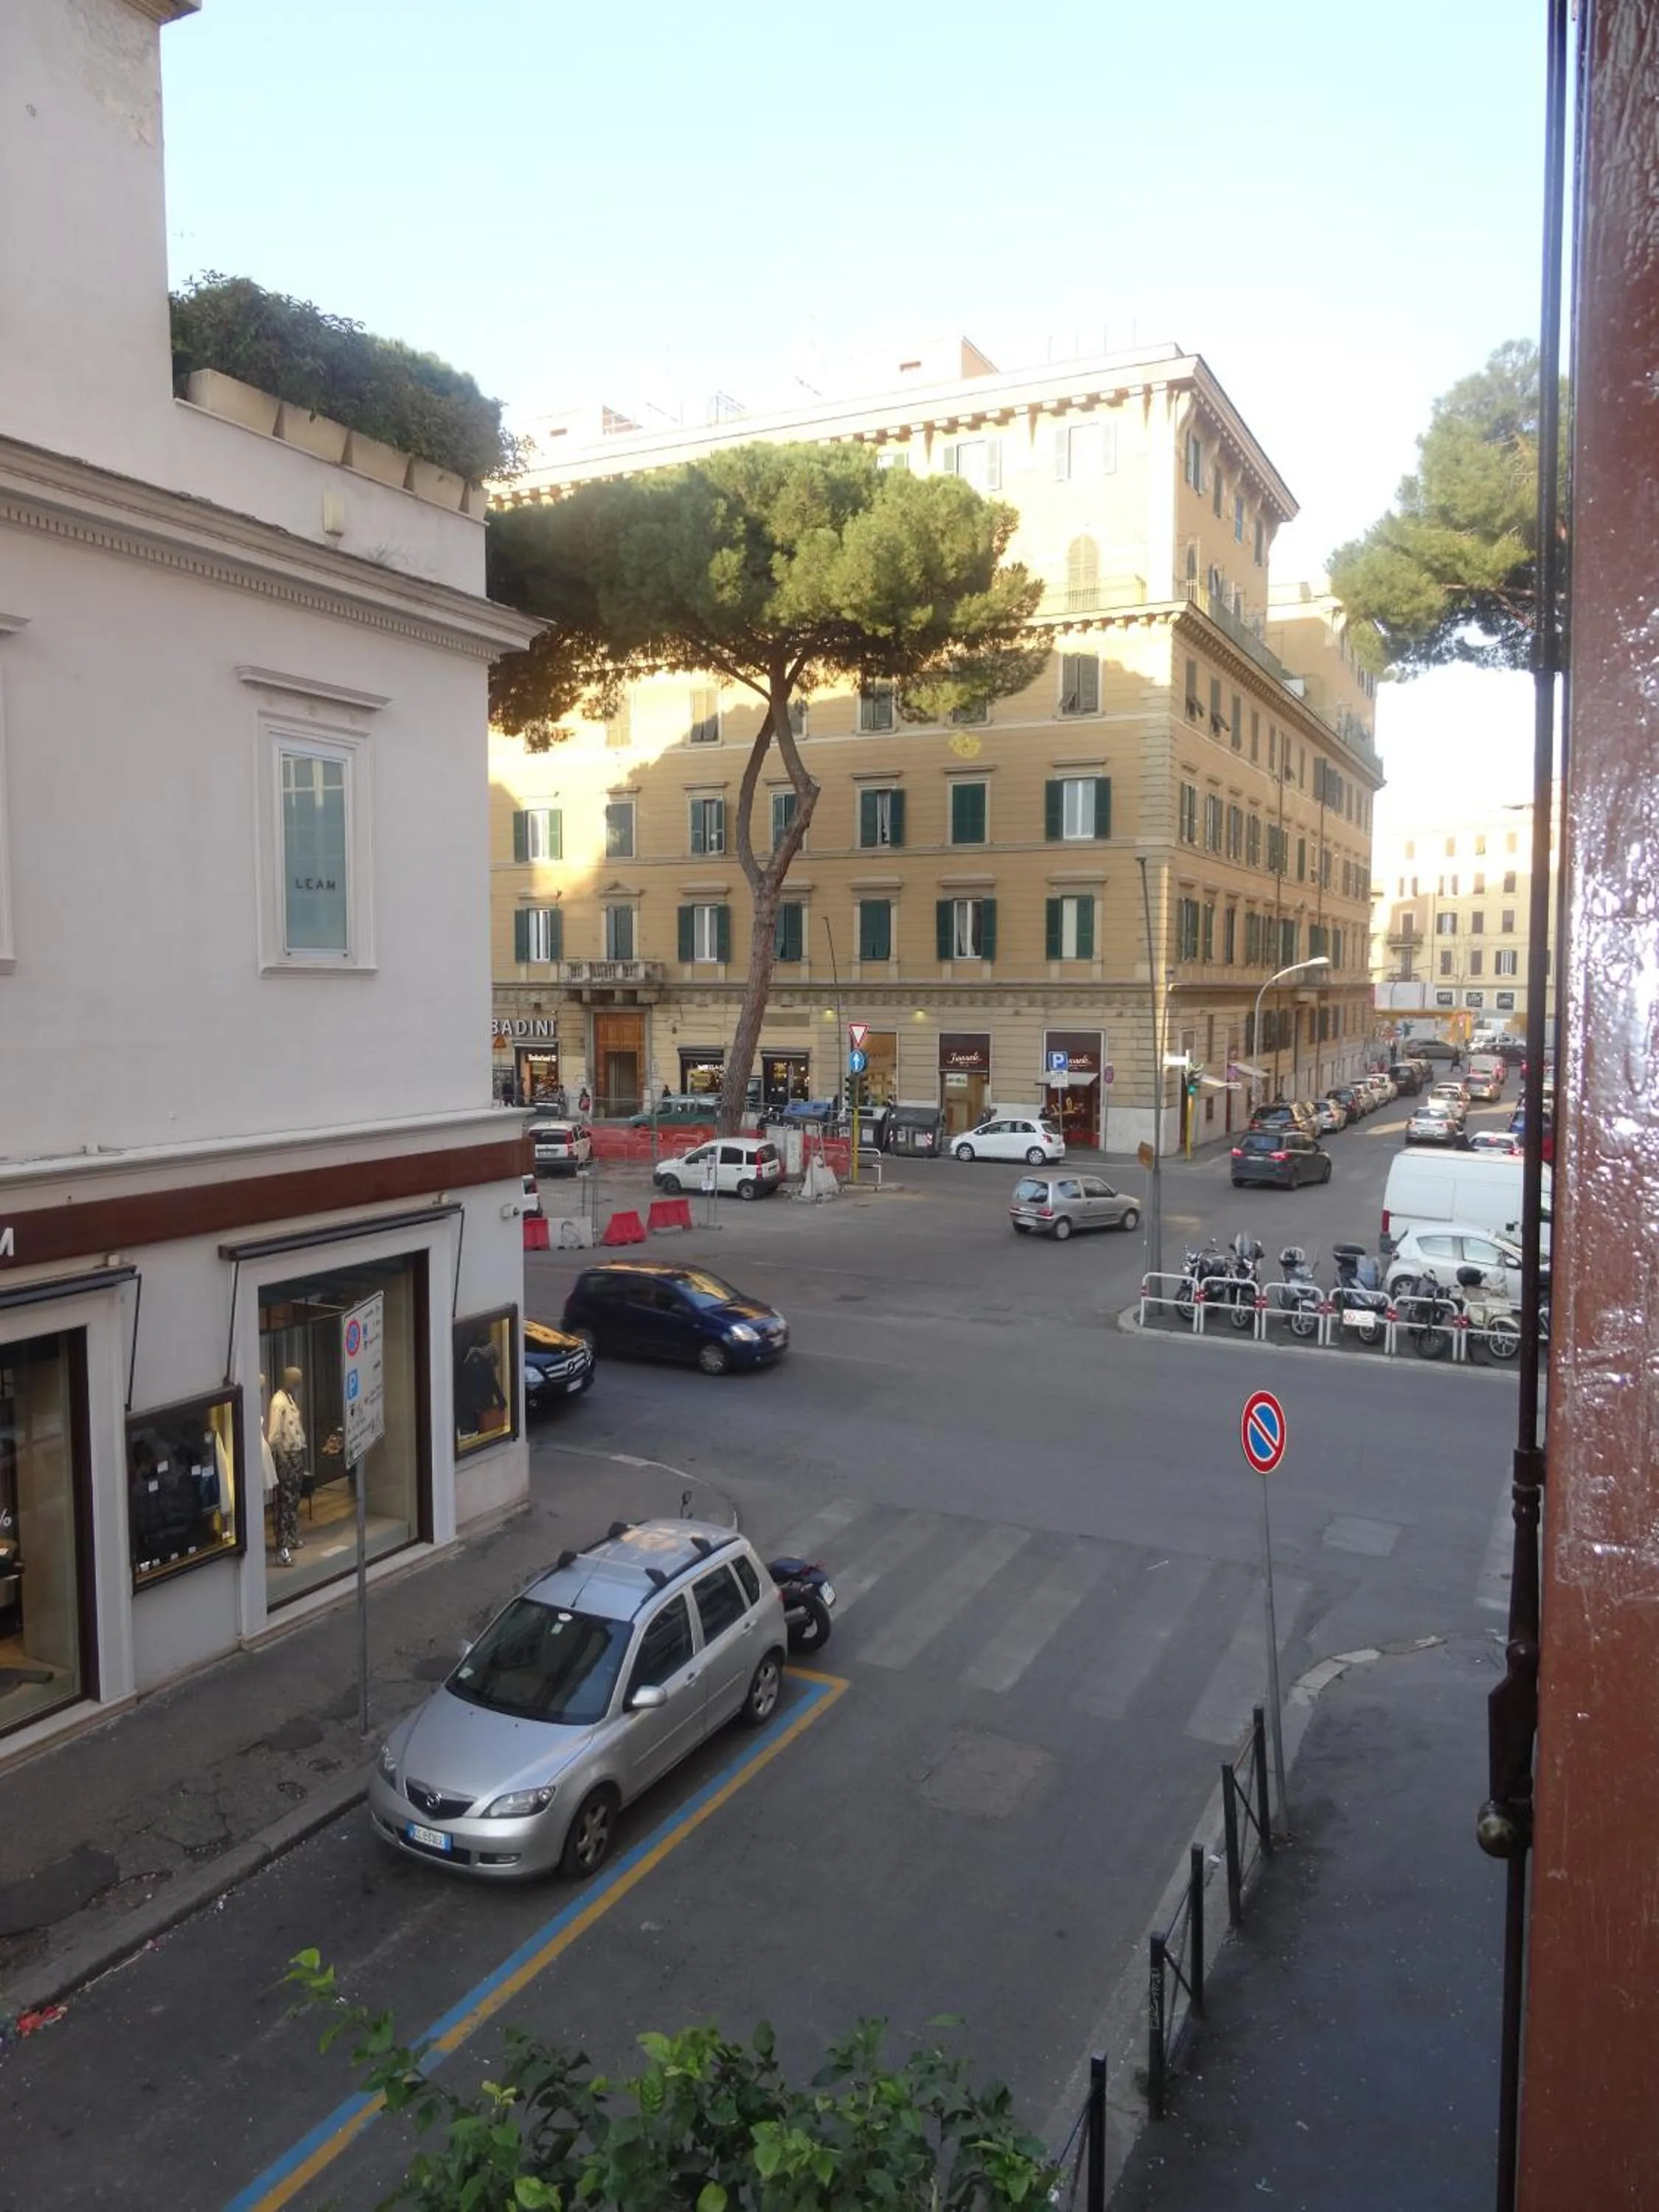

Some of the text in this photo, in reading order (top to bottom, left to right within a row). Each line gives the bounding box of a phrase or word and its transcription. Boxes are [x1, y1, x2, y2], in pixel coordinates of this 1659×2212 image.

[296, 878, 335, 891] LEAM
[1052, 1054, 1065, 1068] P
[349, 1374, 356, 1396] P
